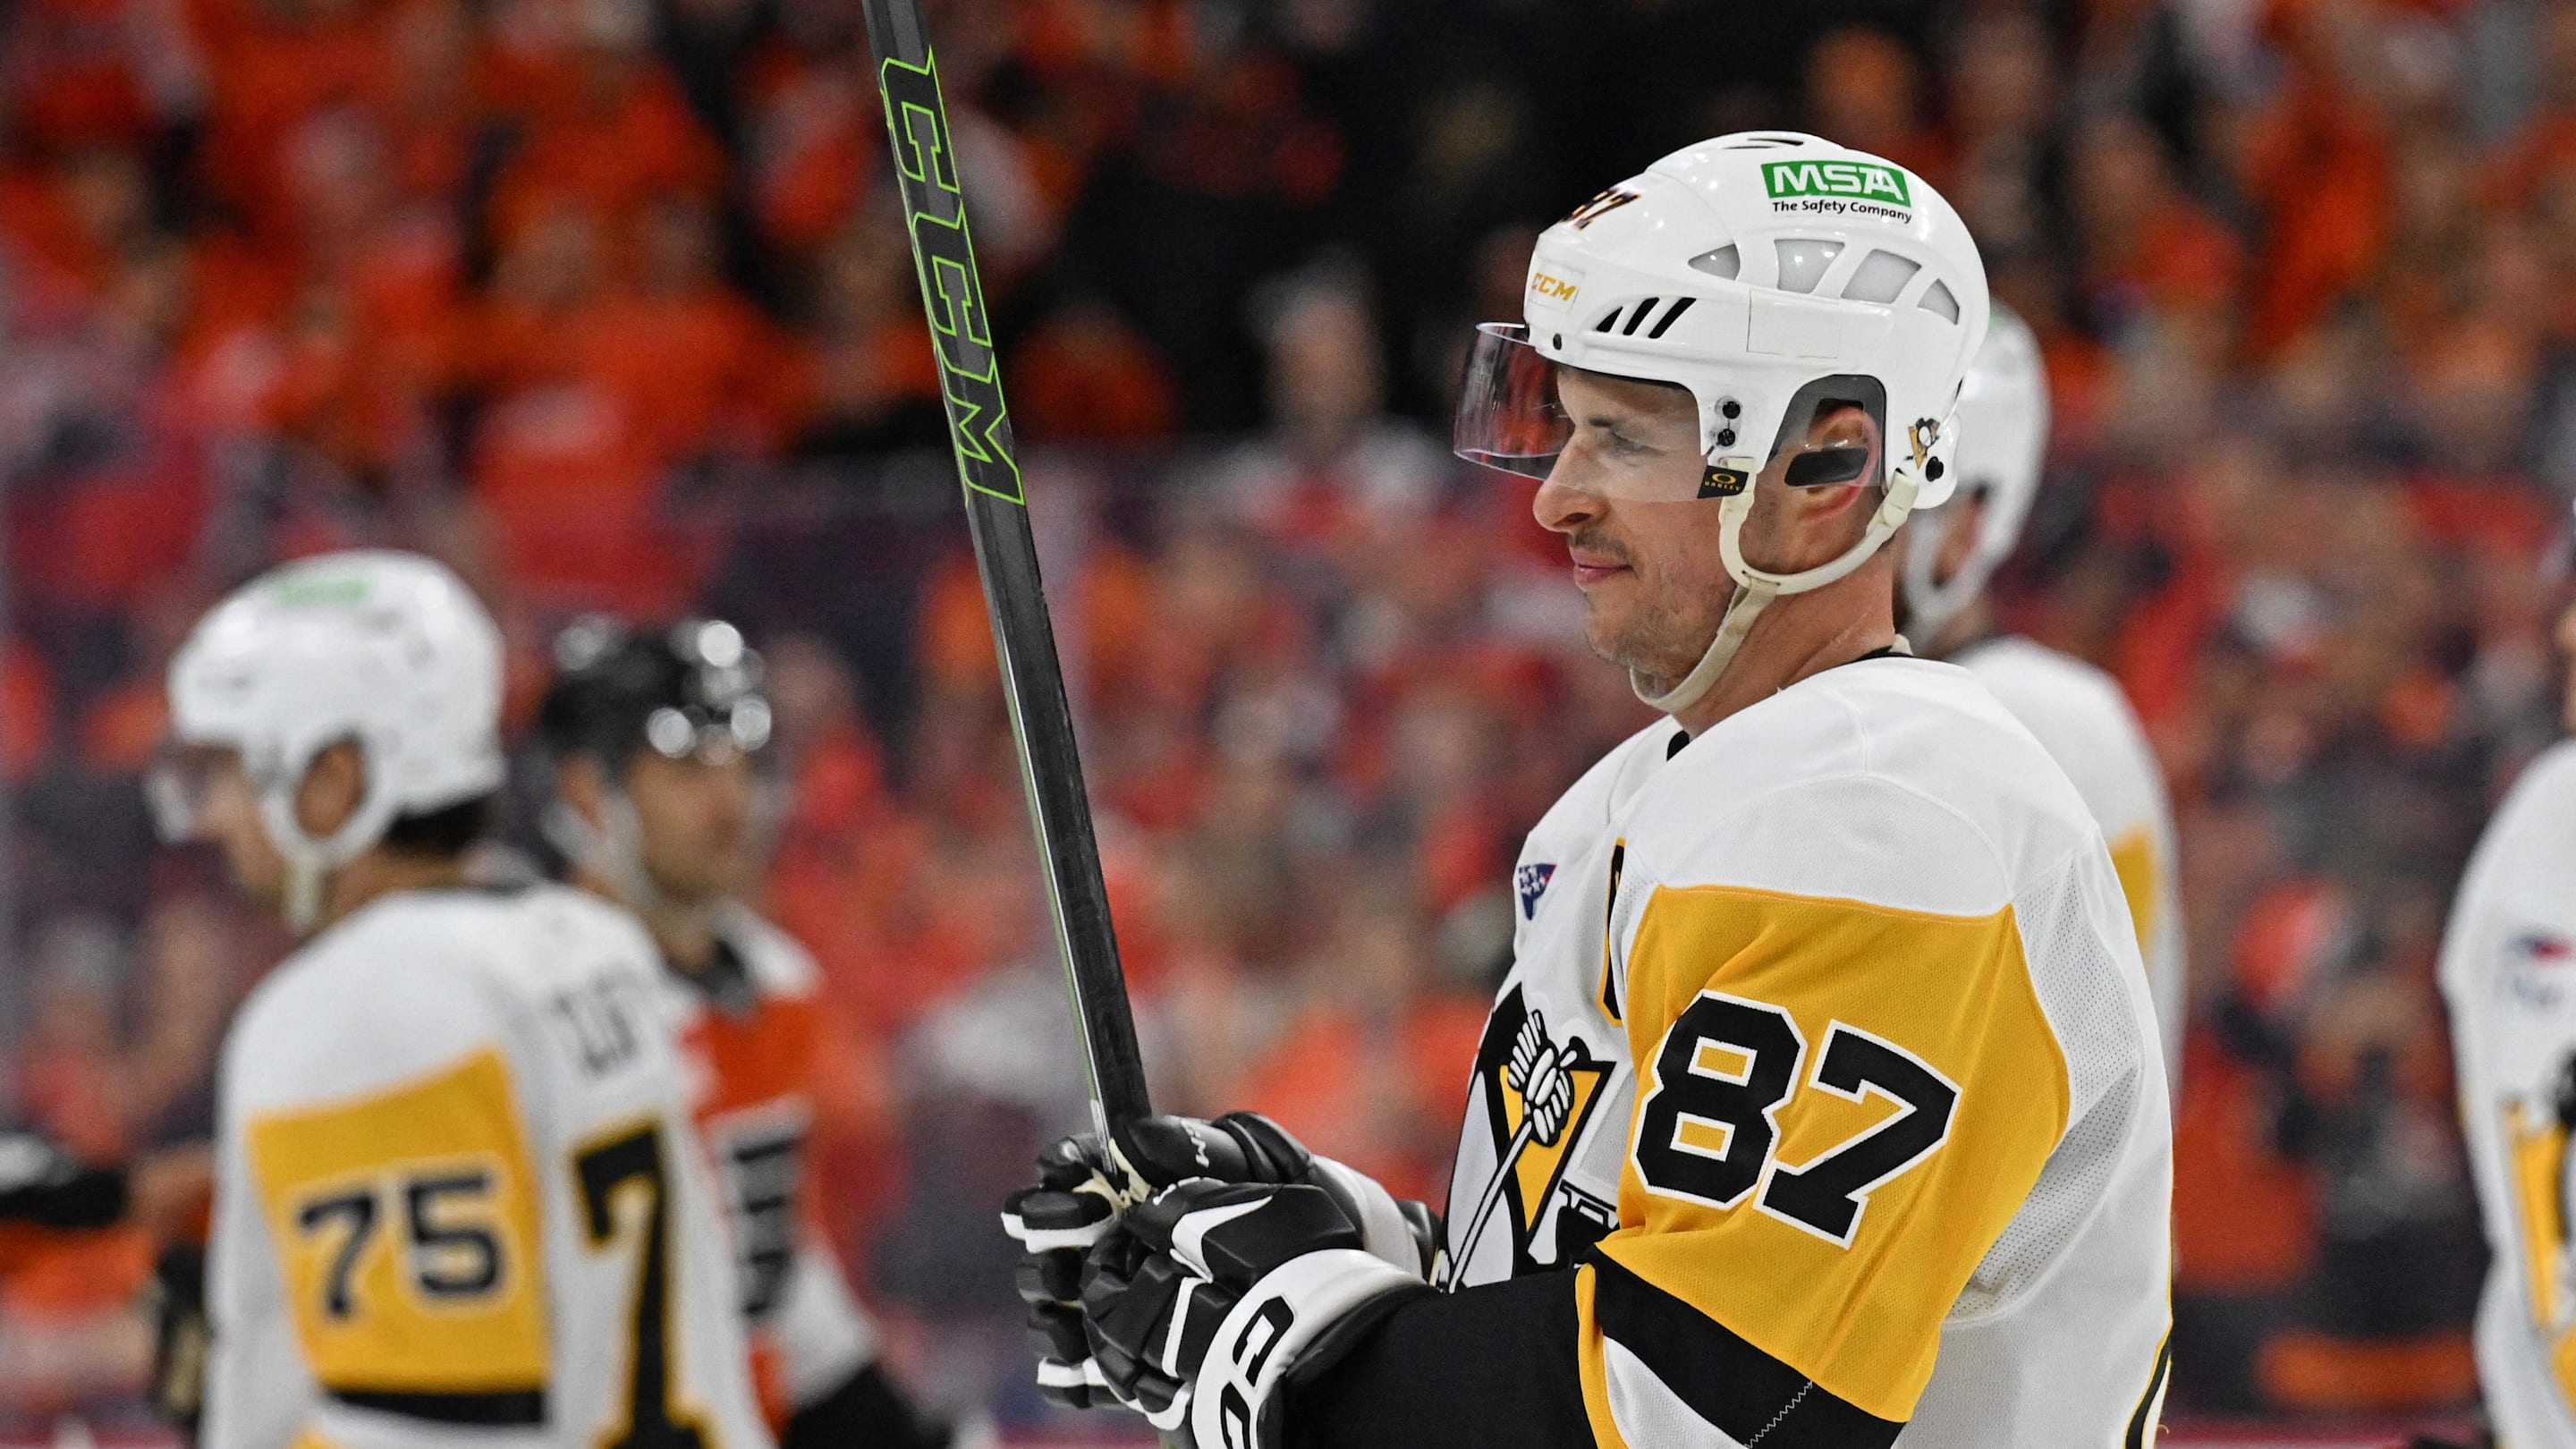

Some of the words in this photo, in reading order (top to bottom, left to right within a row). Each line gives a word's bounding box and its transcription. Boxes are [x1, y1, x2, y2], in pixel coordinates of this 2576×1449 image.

[1772, 164, 1905, 201] MSA
[1773, 199, 1798, 213] The
[1801, 199, 1846, 215] Safety
[1850, 201, 1912, 224] Company
[881, 45, 1025, 505] CCM
[1531, 272, 1577, 301] CCM
[1631, 988, 1962, 1249] 87
[295, 1167, 505, 1322] 75
